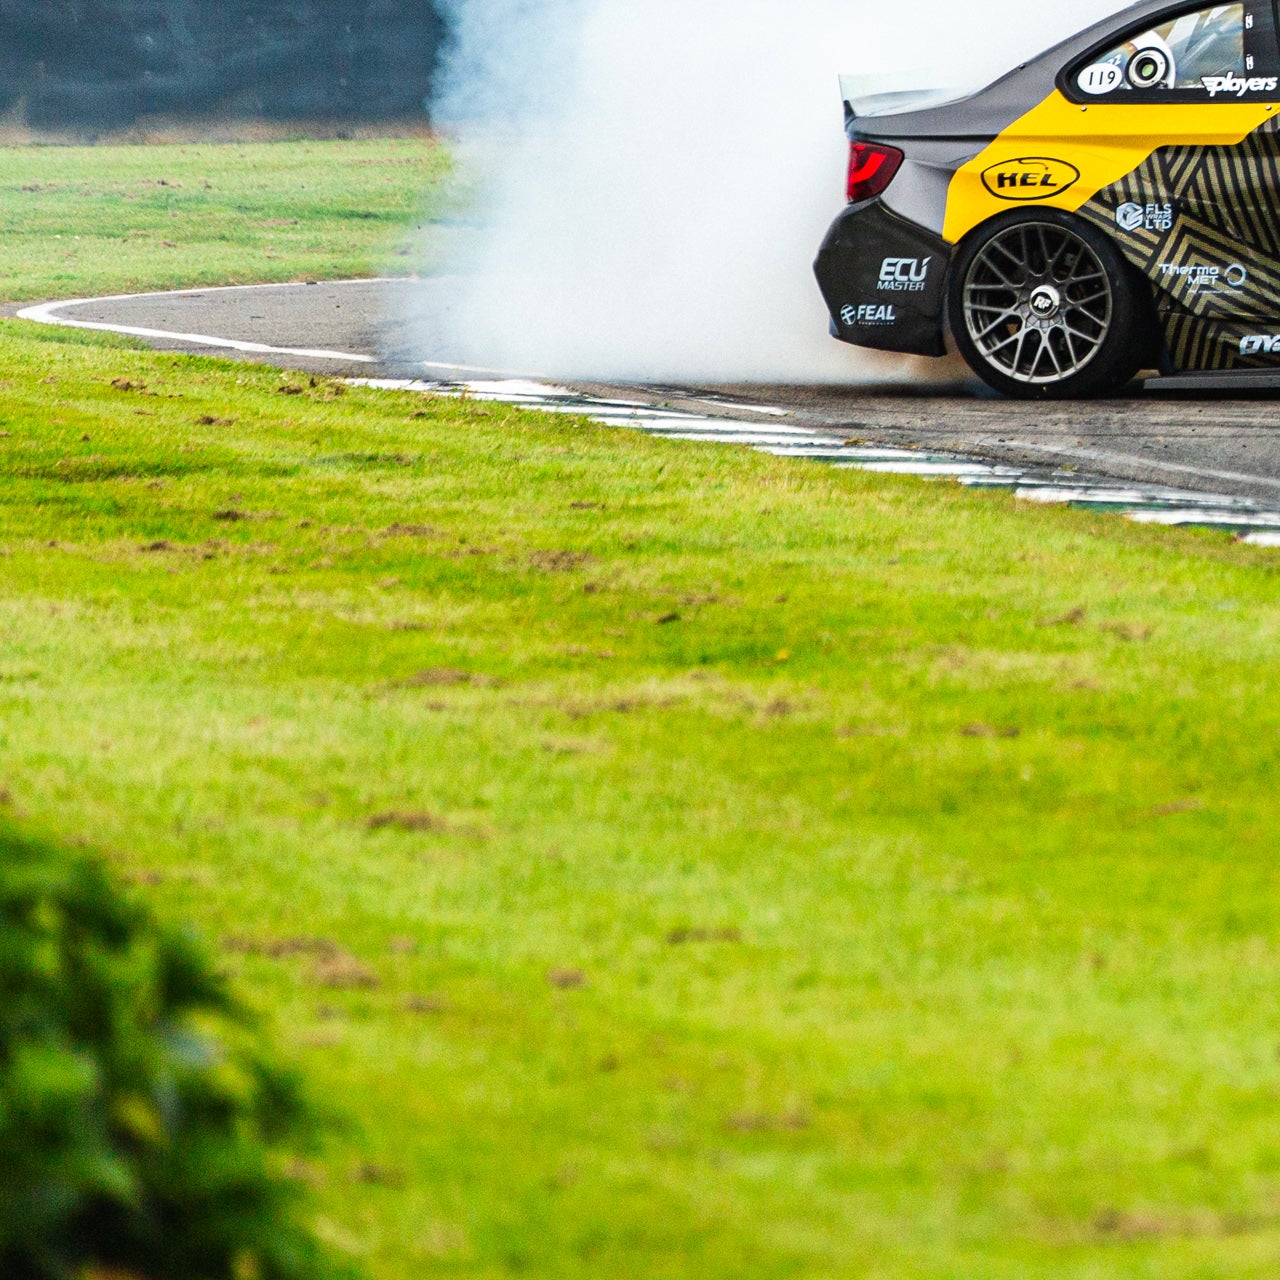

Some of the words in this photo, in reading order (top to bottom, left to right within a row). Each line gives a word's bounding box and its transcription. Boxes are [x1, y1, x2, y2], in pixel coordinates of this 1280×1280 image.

[1089, 70, 1116, 86] 119
[1201, 71, 1278, 97] players
[997, 172, 1058, 188] HEL
[1145, 203, 1172, 214] FLS
[1145, 220, 1172, 230] LTD
[878, 255, 932, 282] ECU
[876, 280, 925, 291] MASTER
[1187, 275, 1219, 285] MET
[856, 304, 896, 320] FEAL
